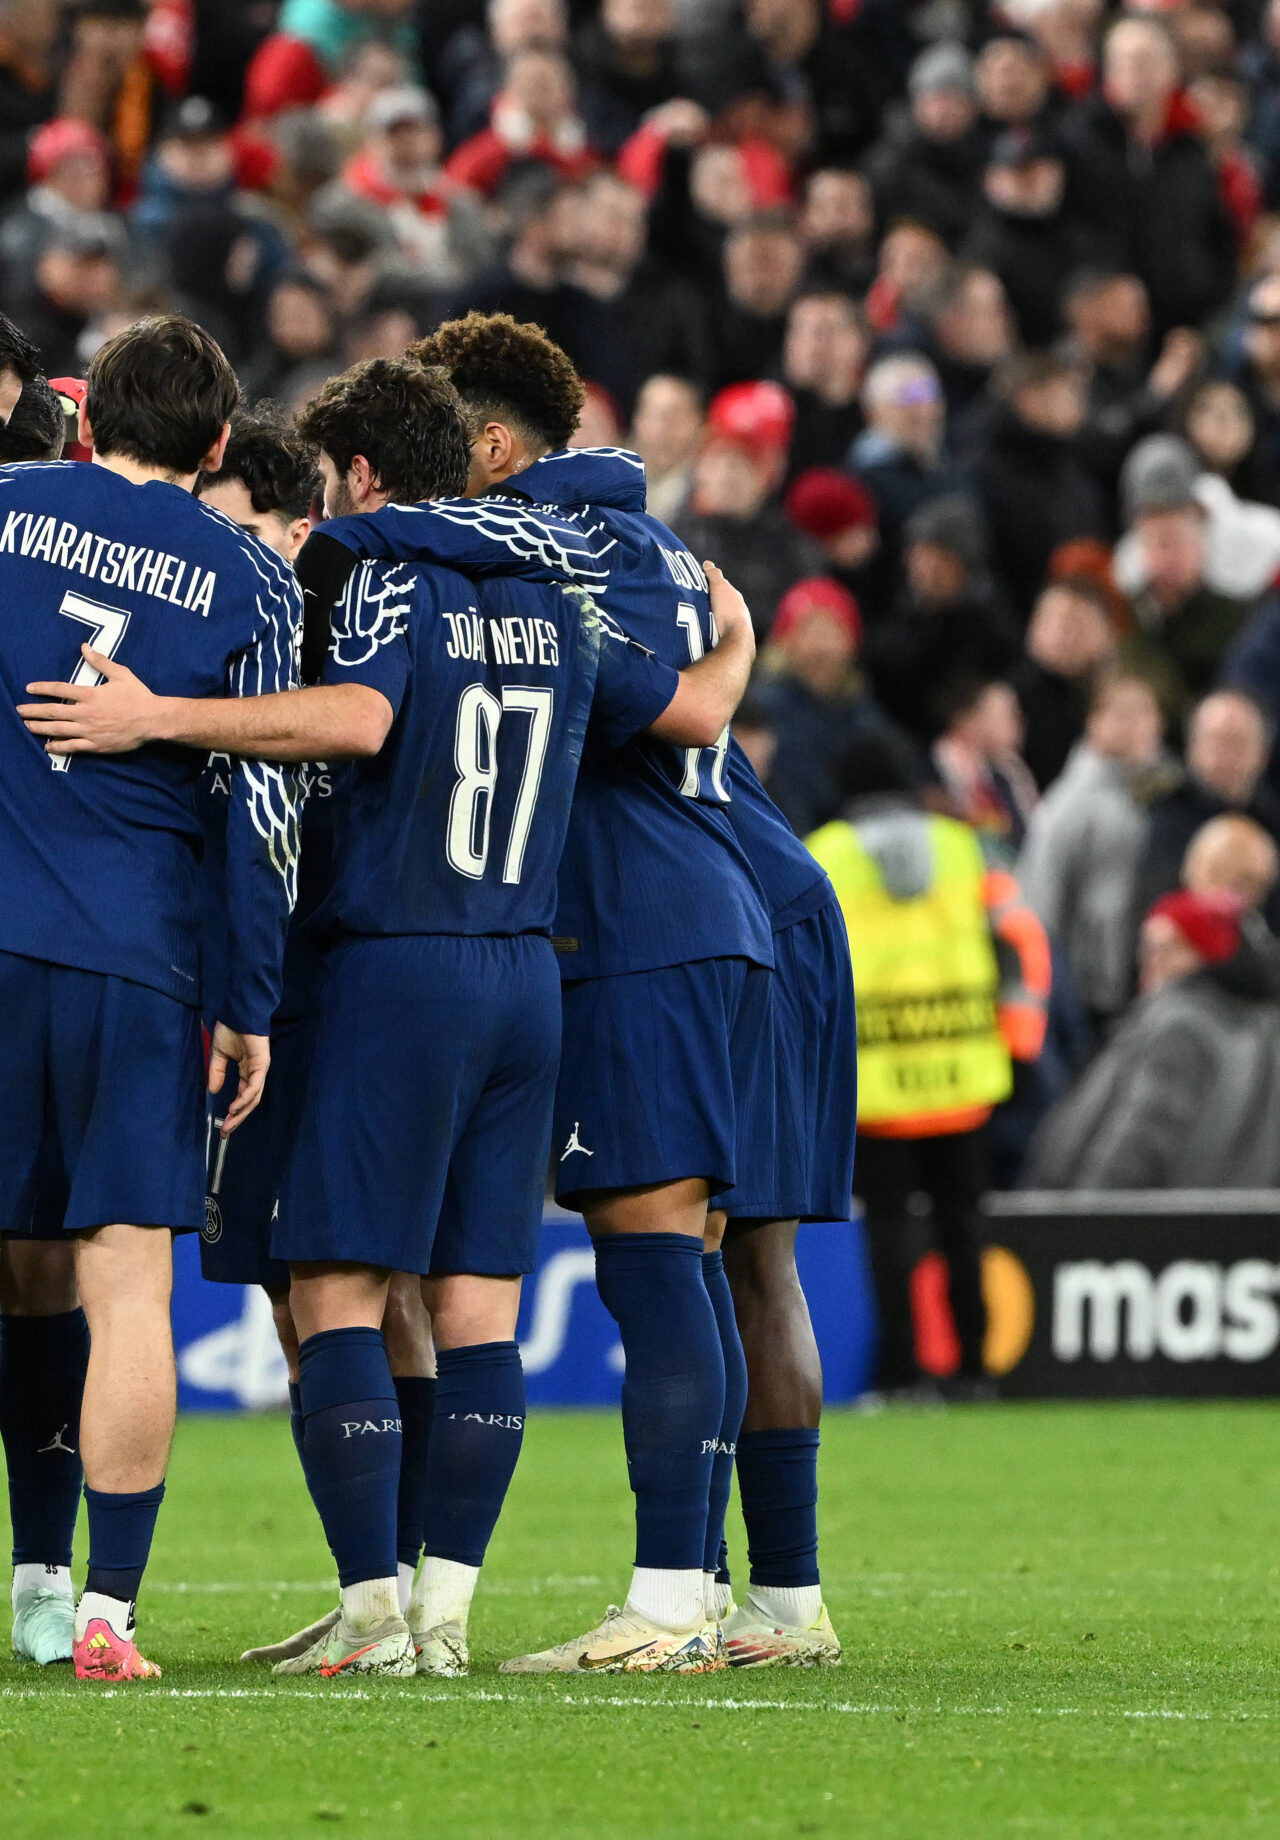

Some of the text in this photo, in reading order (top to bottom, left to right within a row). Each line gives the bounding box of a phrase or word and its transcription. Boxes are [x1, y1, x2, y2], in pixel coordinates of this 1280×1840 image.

[46, 590, 132, 773] 7
[489, 617, 559, 667] NEVES
[446, 682, 554, 885] 87
[1052, 1259, 1280, 1363] mas
[448, 1413, 523, 1430] ARIS
